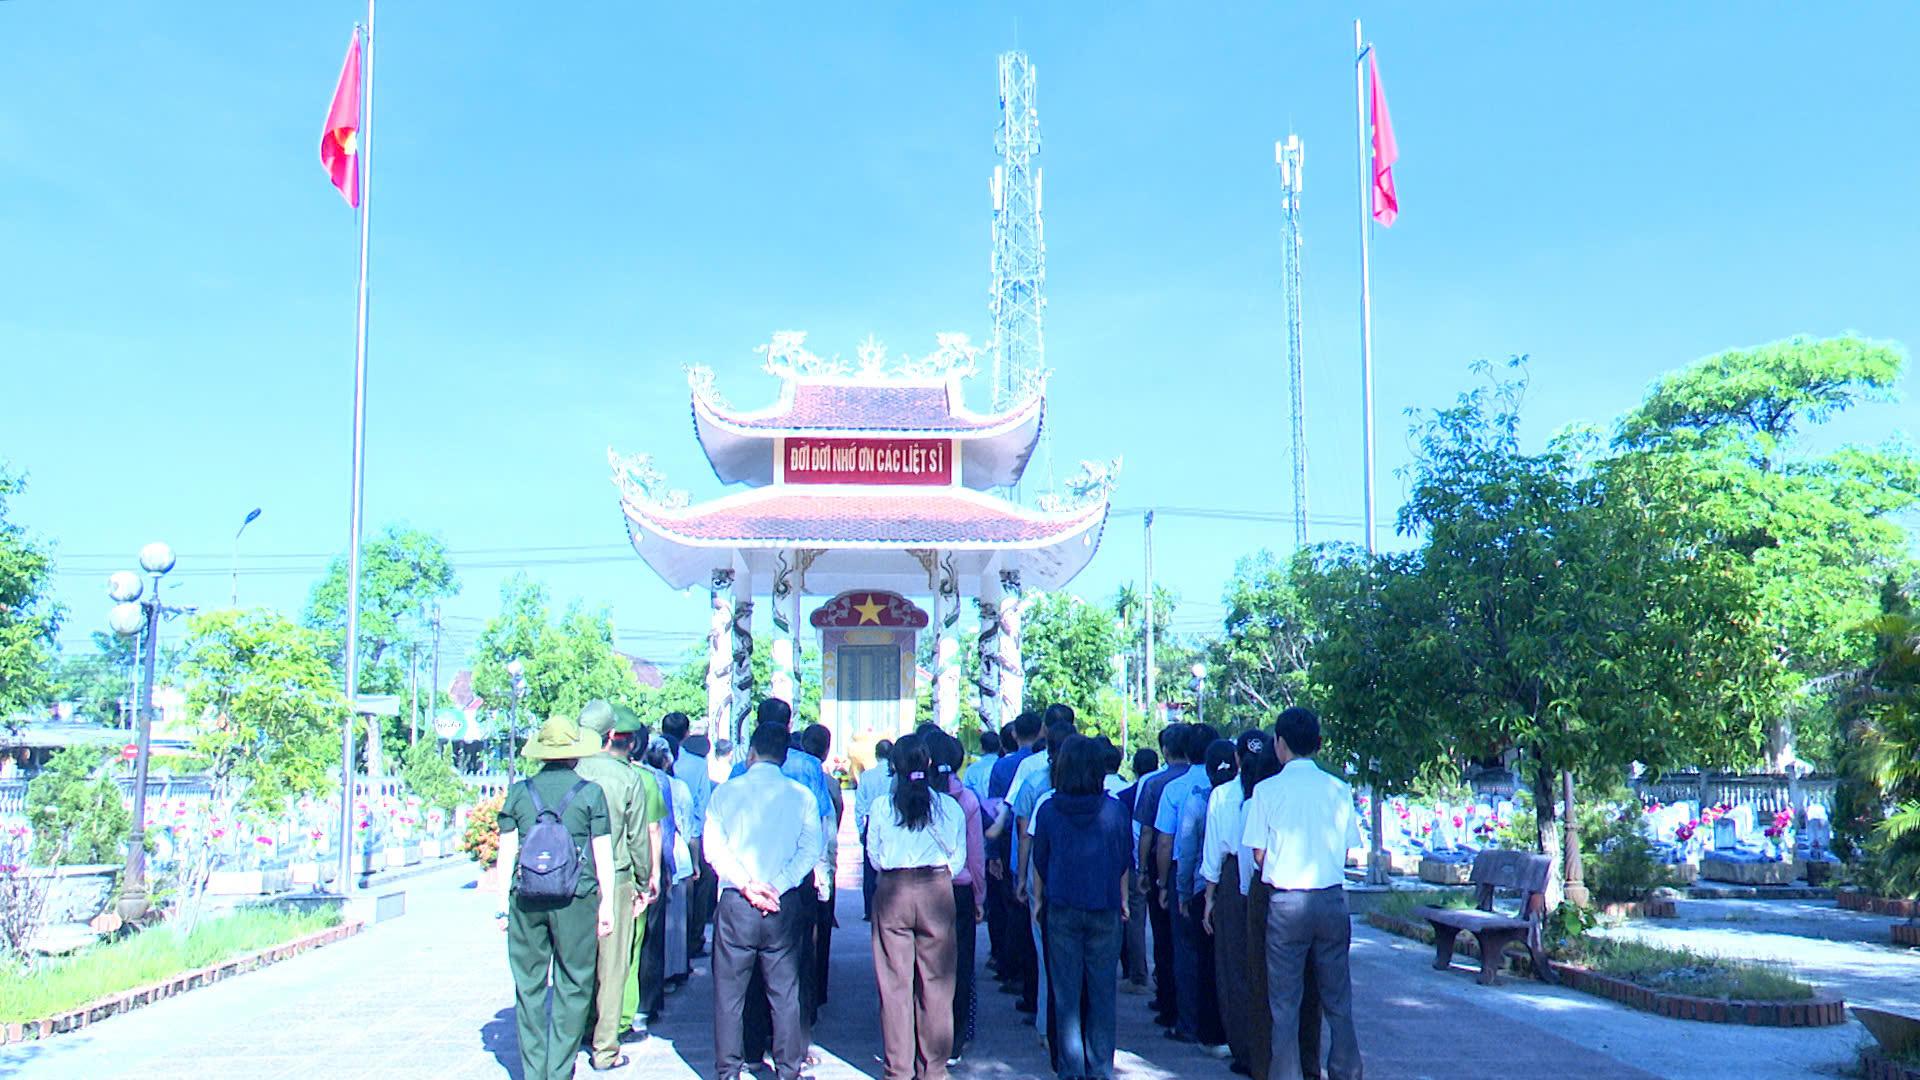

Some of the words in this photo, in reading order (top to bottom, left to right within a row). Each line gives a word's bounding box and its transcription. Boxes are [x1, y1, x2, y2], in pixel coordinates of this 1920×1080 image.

[791, 441, 810, 471] ĐỜI
[812, 442, 831, 472] ĐỜI
[832, 442, 857, 472] NHỚ
[858, 447, 875, 472] ƠN
[877, 443, 901, 473] CÁC
[902, 442, 926, 475] LIỆT
[929, 442, 943, 473] SĨ
